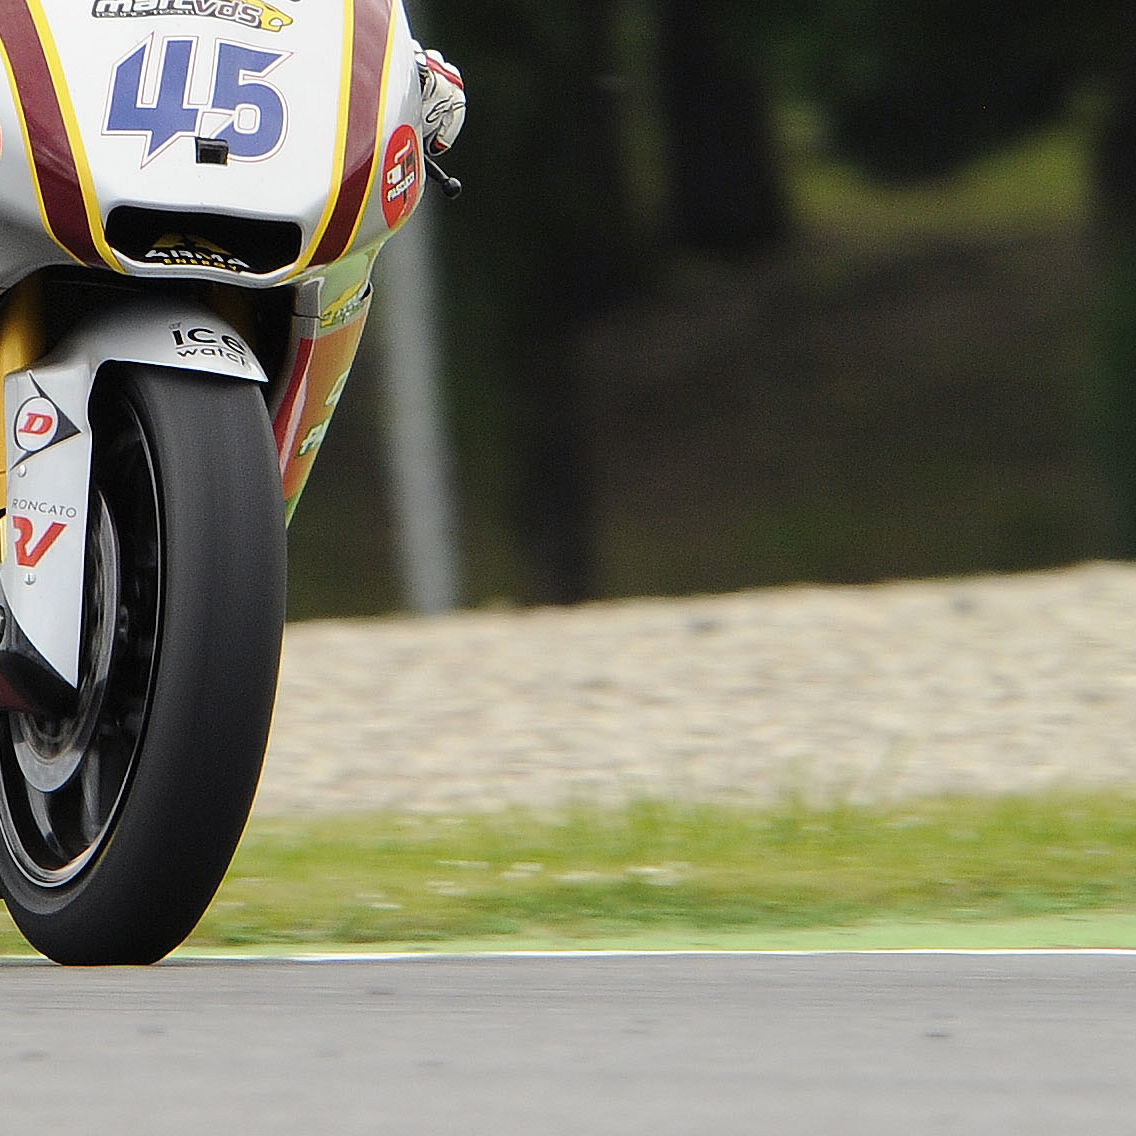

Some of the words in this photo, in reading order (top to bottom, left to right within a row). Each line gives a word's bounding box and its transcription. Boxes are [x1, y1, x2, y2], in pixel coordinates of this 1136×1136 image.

[104, 36, 289, 163] 45
[172, 328, 246, 355] ice
[18, 412, 53, 435] D
[12, 498, 77, 518] RONCATO
